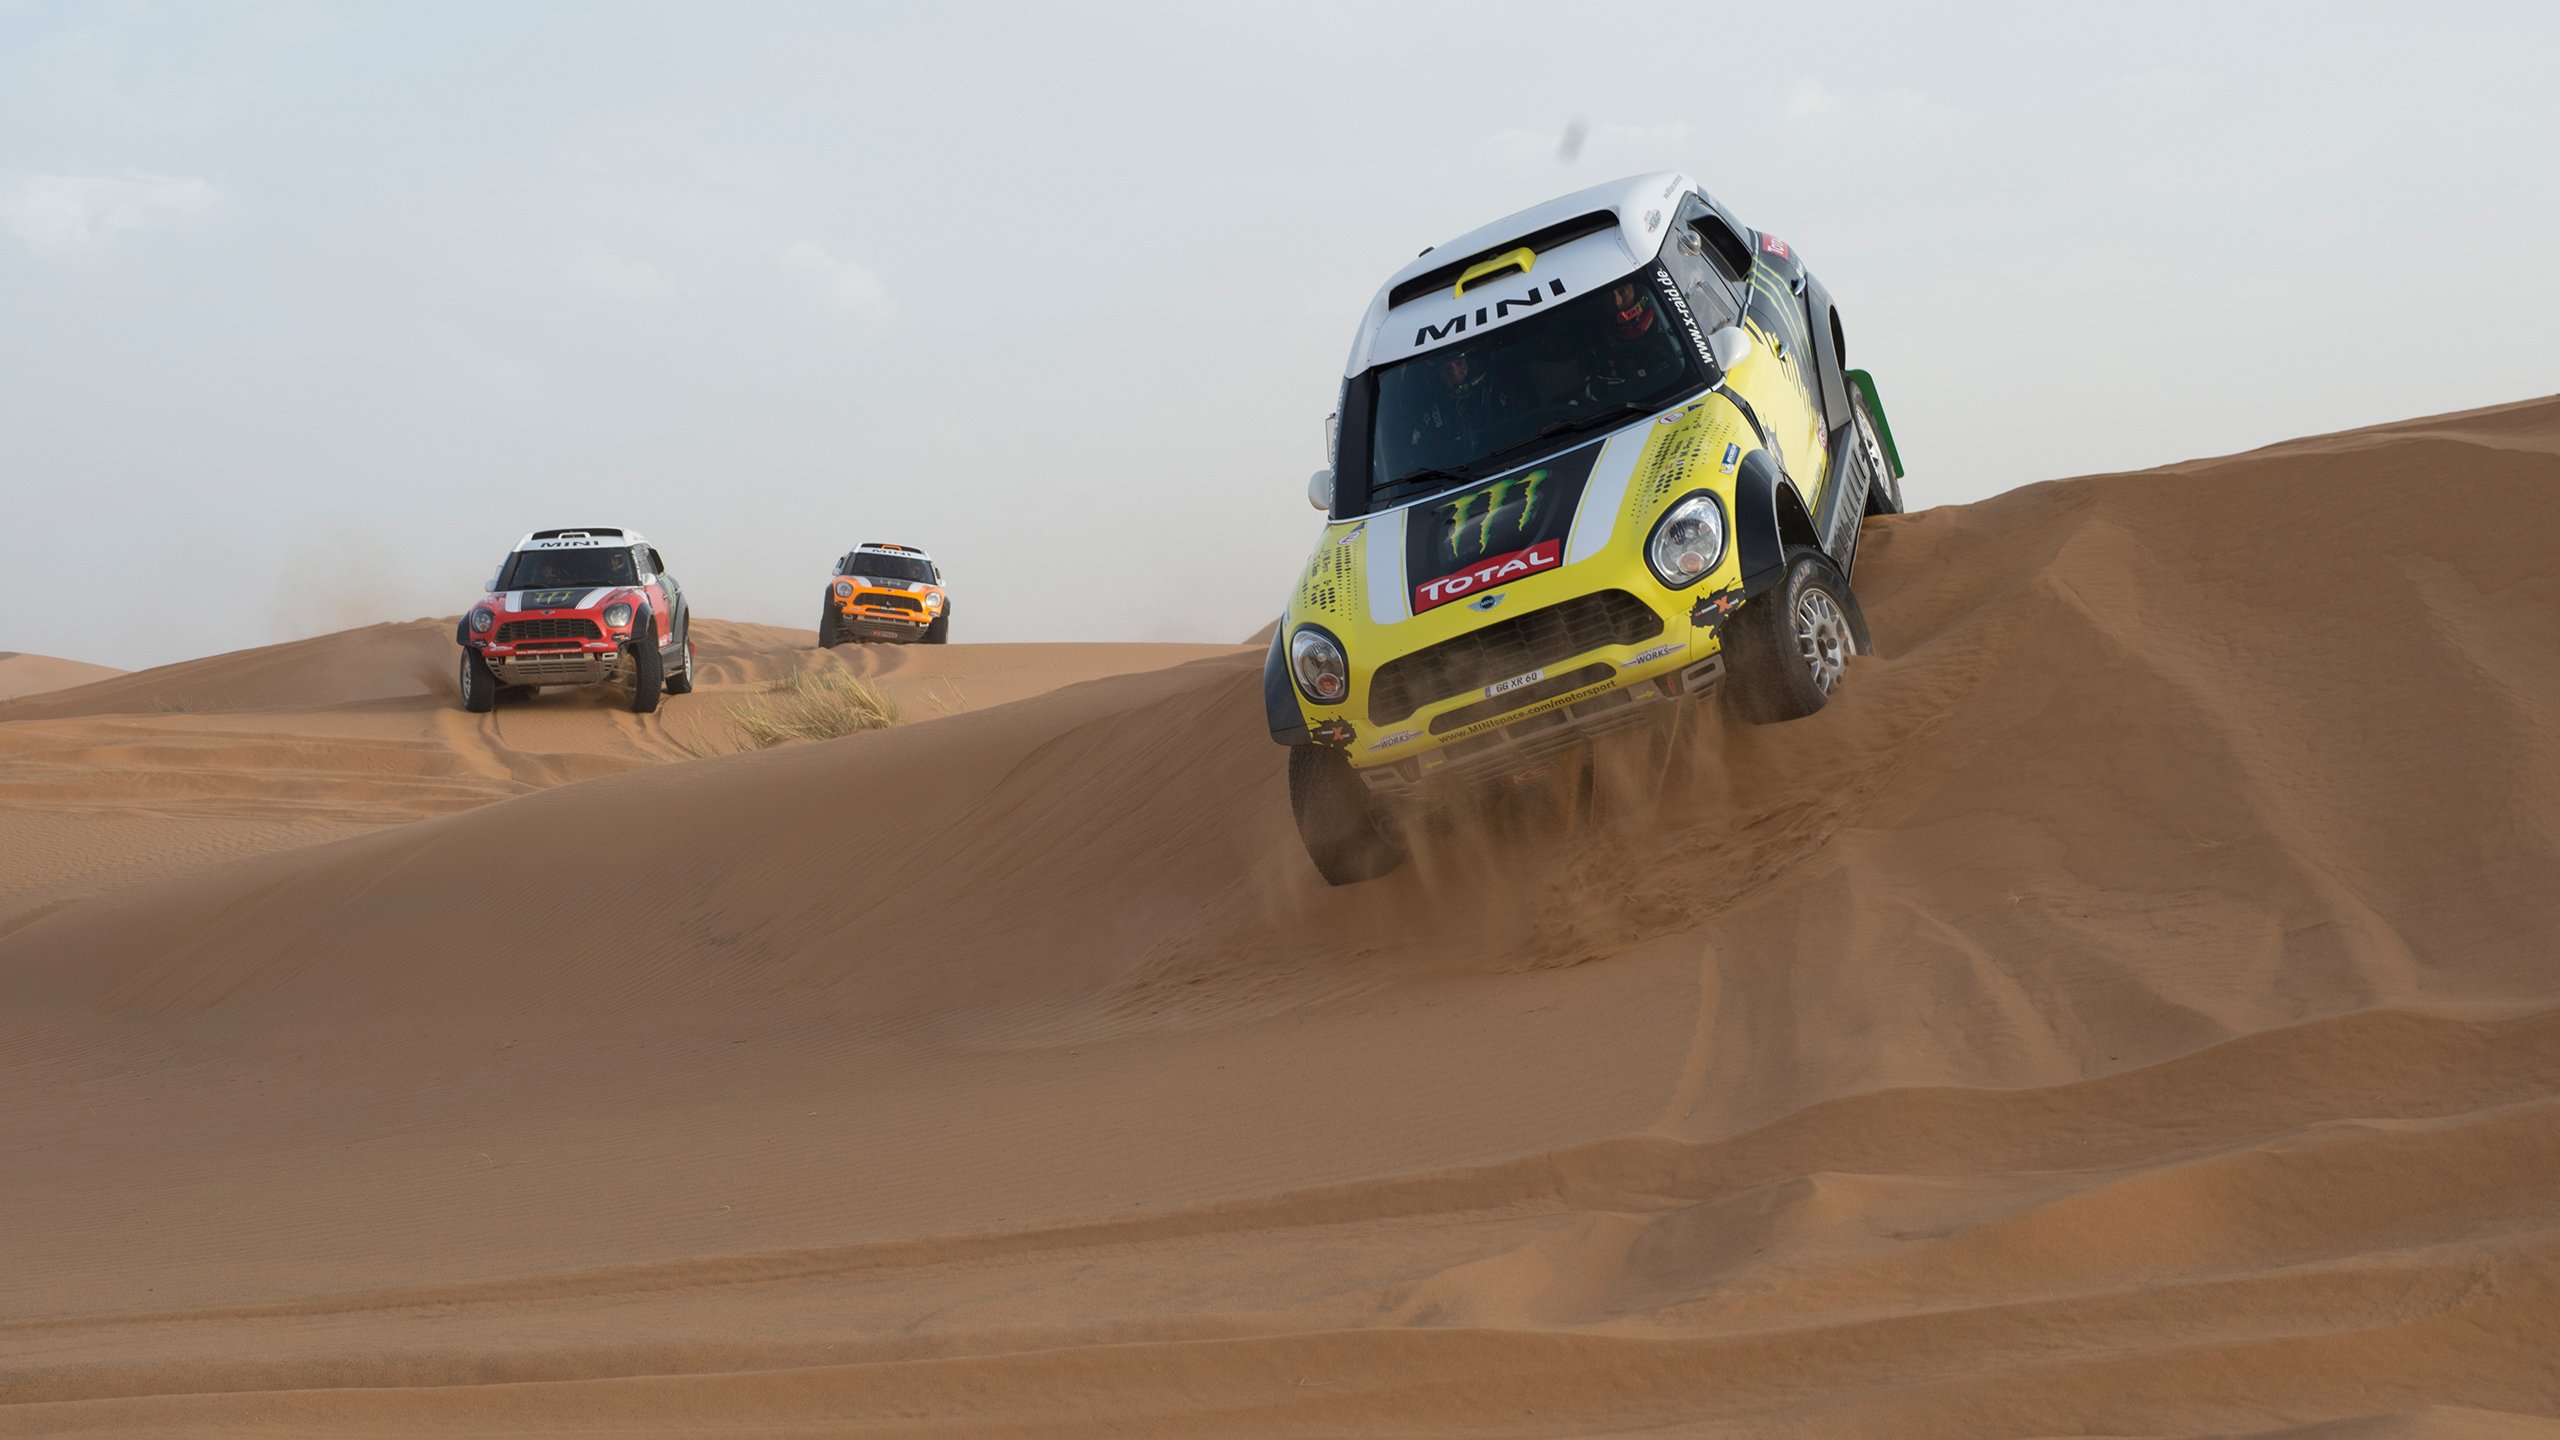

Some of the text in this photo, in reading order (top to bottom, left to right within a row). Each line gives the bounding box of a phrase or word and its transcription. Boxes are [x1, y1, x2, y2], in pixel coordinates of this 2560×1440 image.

[1414, 278, 1567, 347] MINI
[540, 540, 600, 548] MINI
[1420, 551, 1554, 601] TOTAL
[1636, 647, 1671, 665] WORKS
[1496, 672, 1538, 693] GG XR 60
[1438, 680, 1617, 743] www.MINIspace.com/motorsport
[1380, 733, 1410, 749] WORKS
